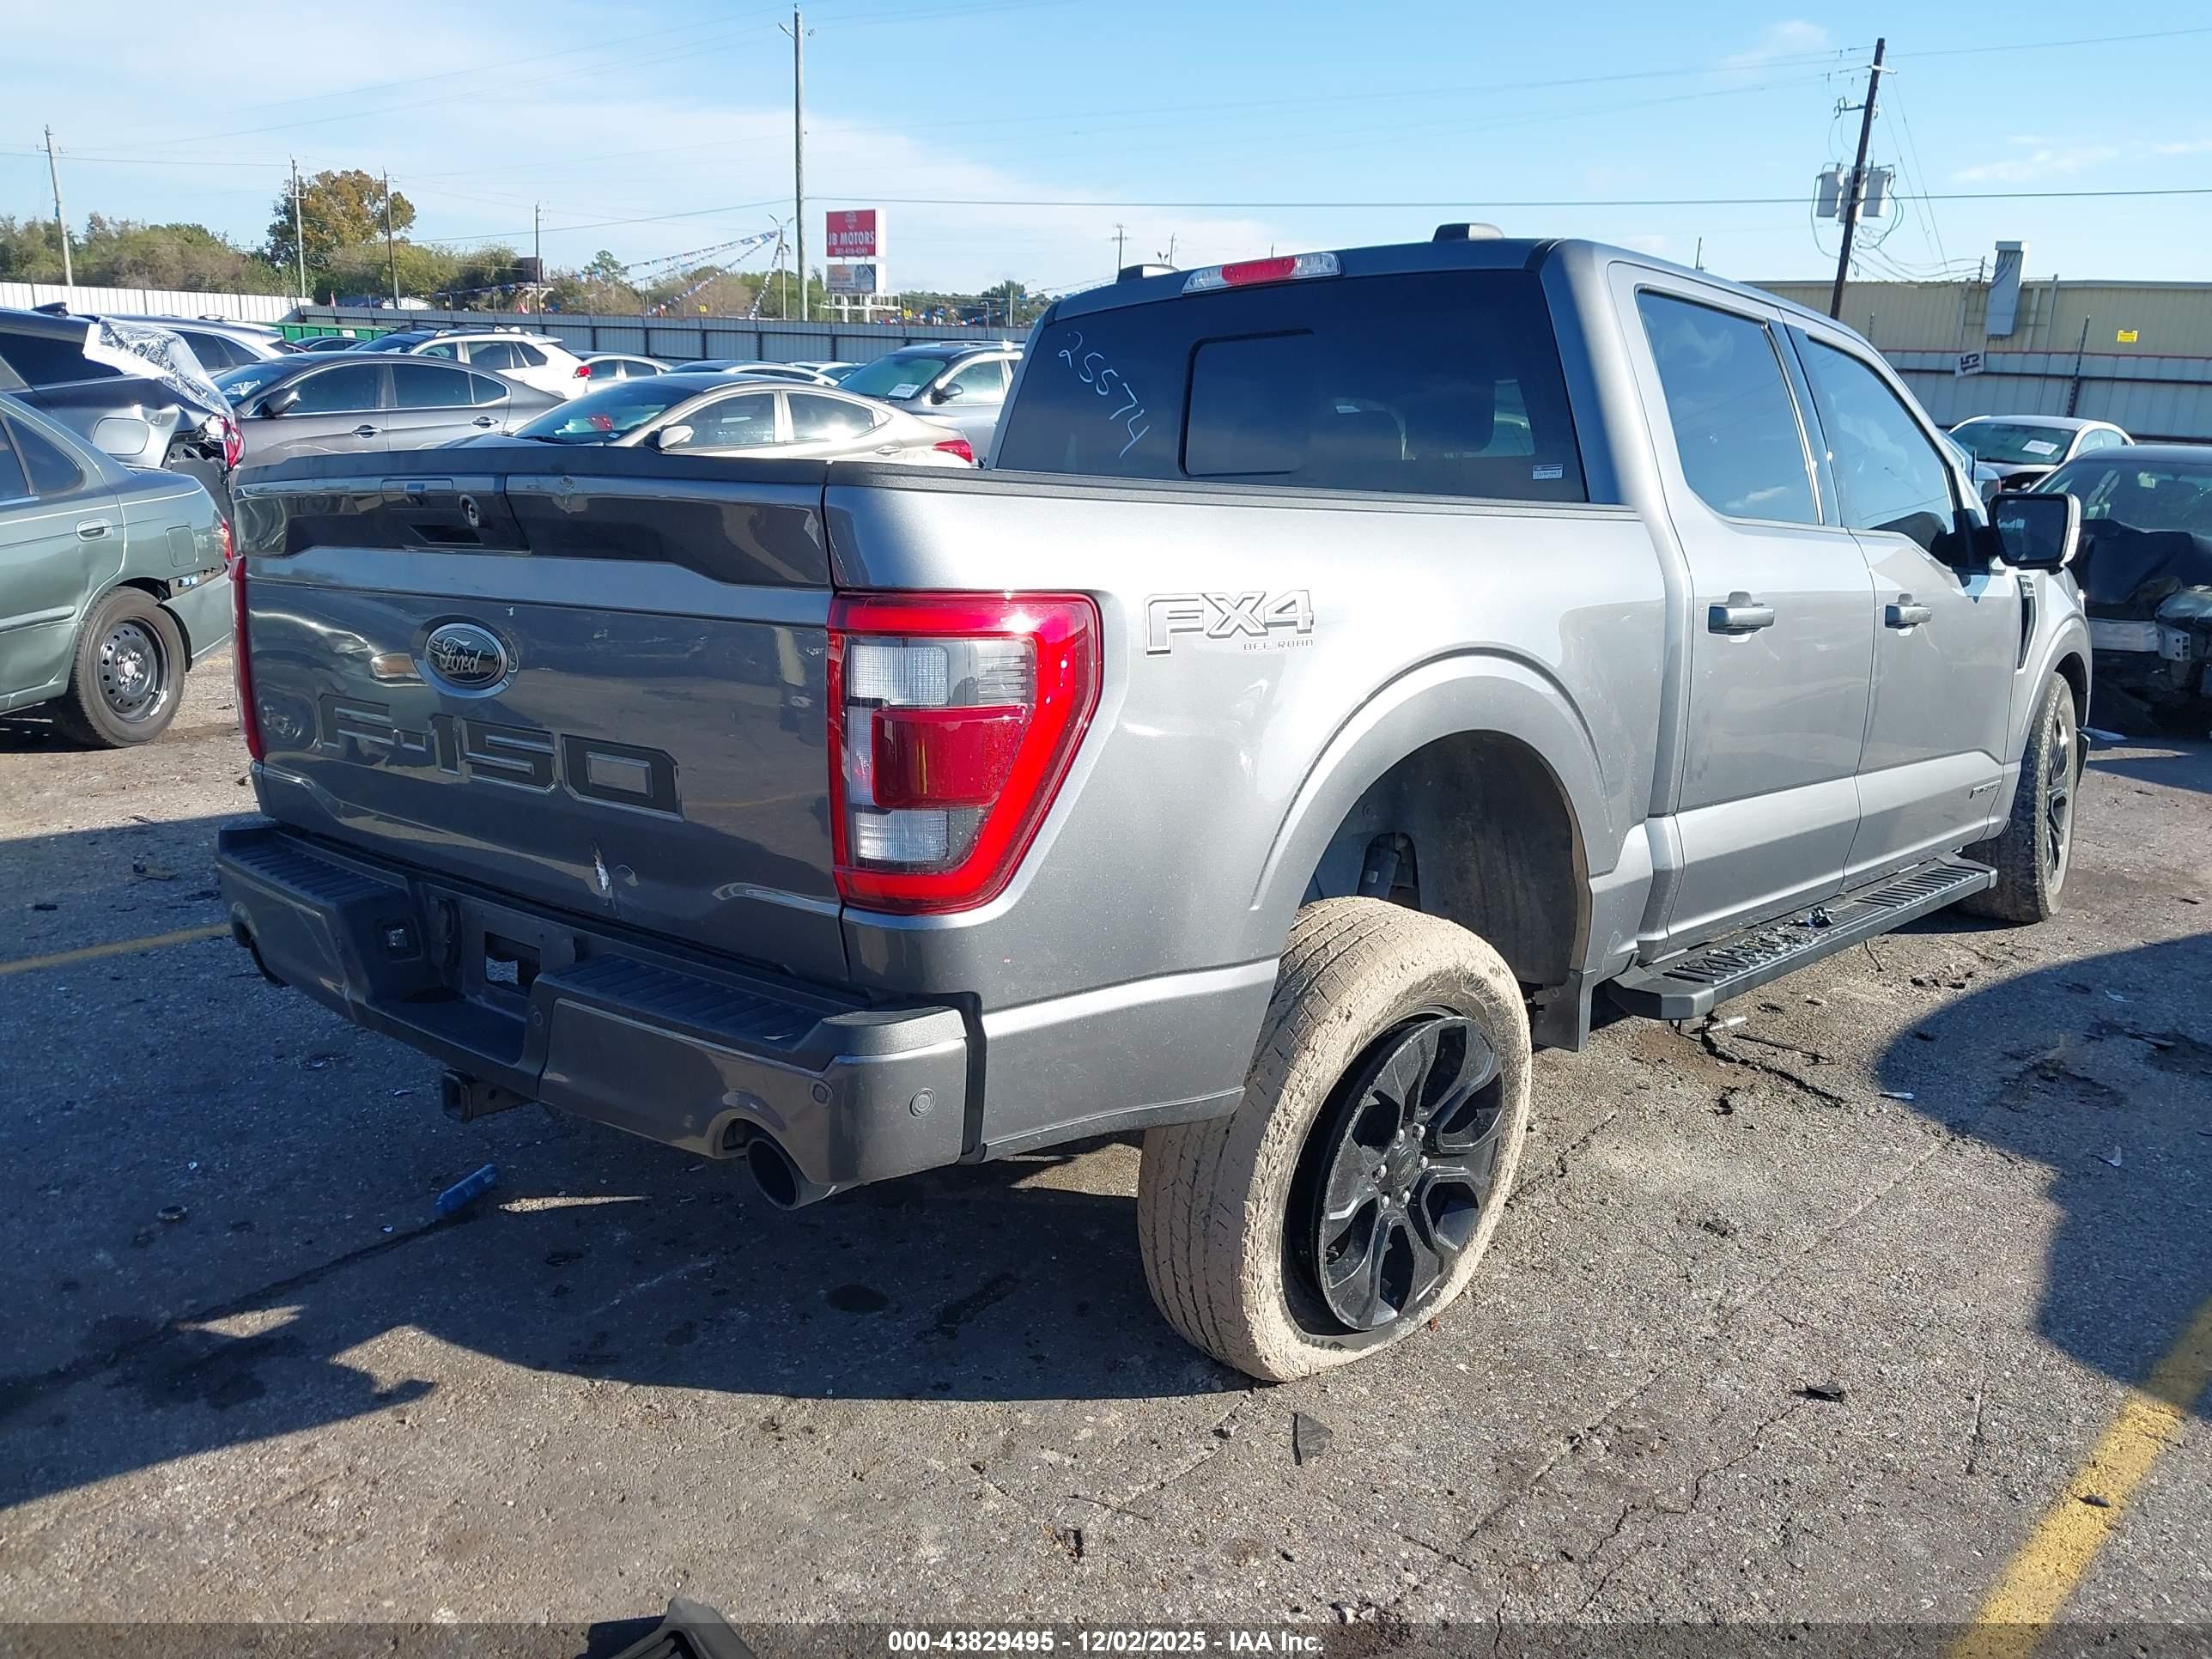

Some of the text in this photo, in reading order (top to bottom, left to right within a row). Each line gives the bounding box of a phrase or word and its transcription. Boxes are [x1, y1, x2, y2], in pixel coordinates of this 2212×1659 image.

[828, 231, 874, 246] JB MOTORS
[1960, 353, 1979, 374] 15
[1144, 590, 1314, 659] FX4
[439, 636, 482, 675] Ford
[1244, 639, 1313, 651] OFF ROAD
[318, 693, 684, 822] F-150
